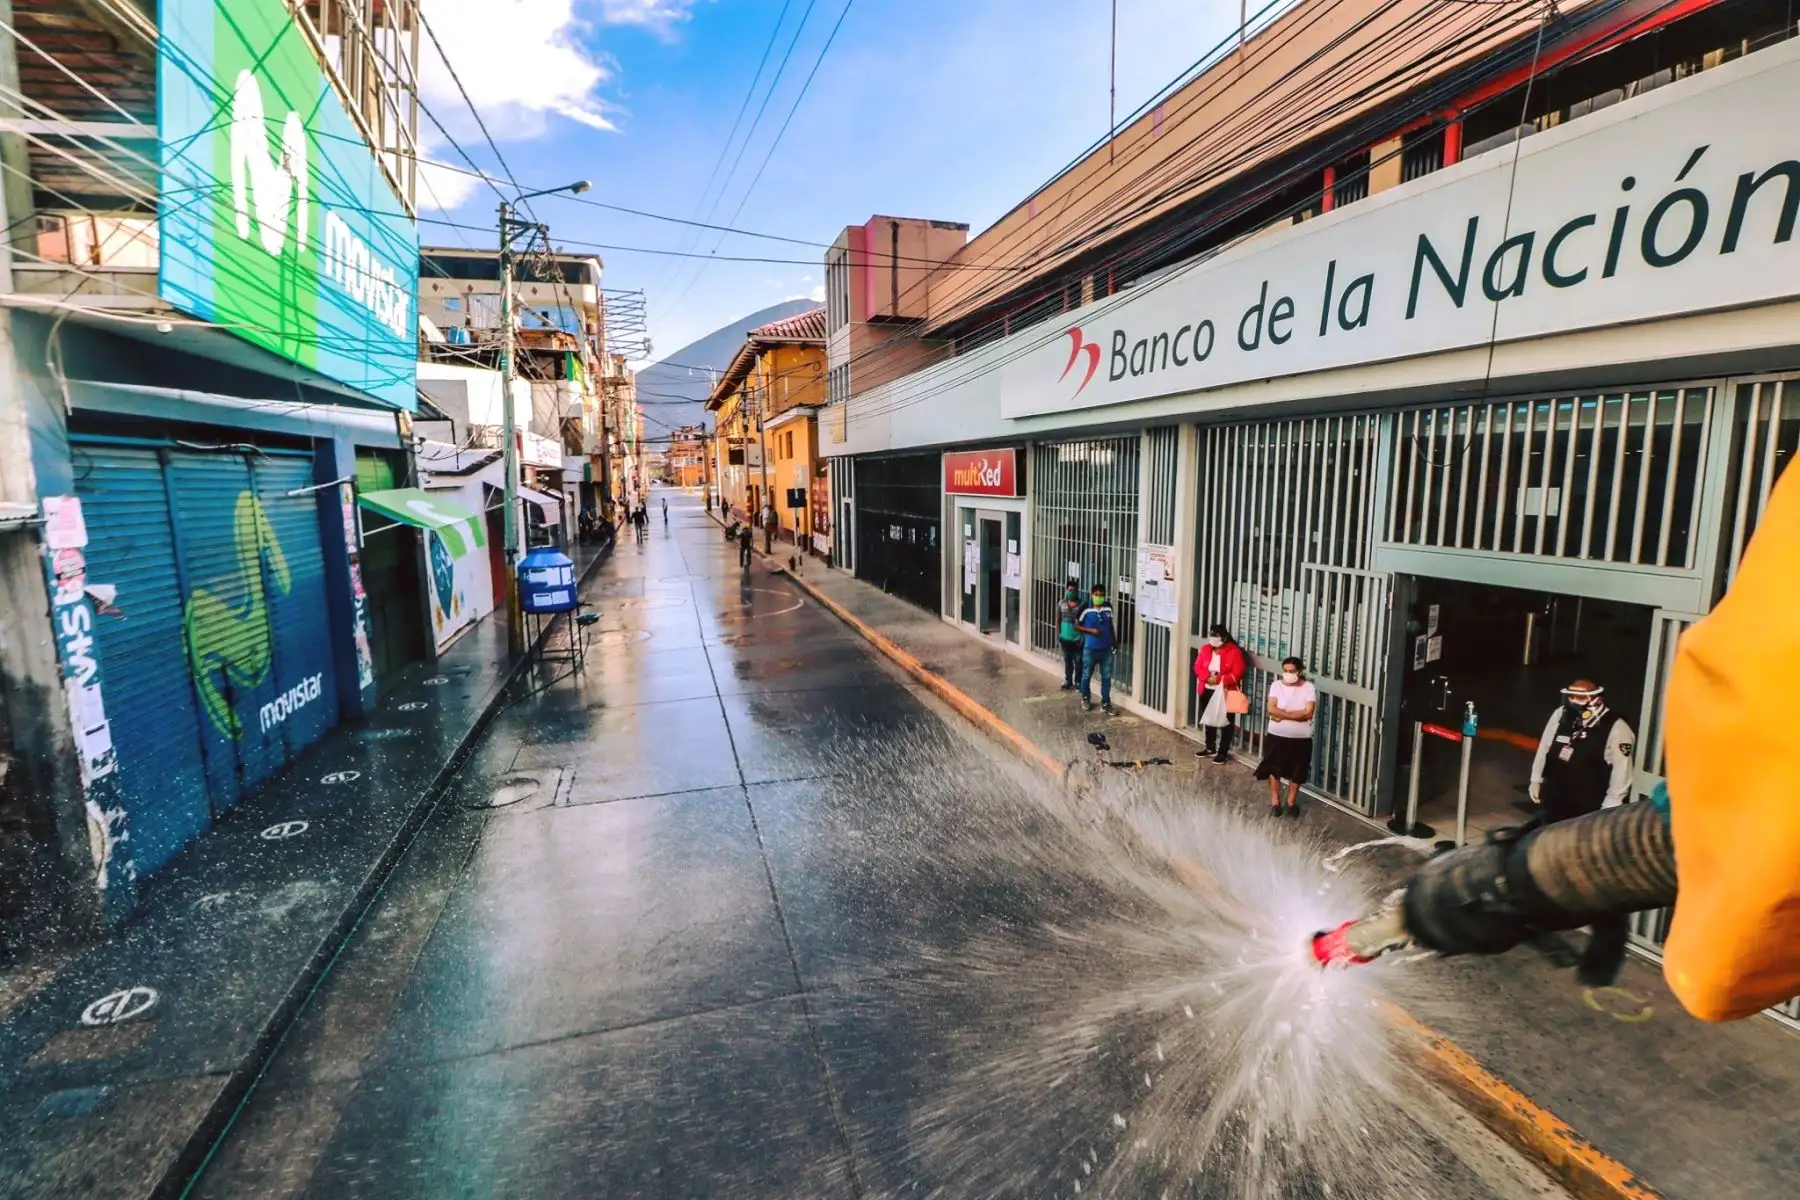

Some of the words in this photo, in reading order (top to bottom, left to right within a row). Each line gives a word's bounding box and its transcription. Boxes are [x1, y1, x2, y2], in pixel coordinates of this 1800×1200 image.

[324, 209, 409, 341] movistar
[1109, 319, 1215, 382] Banco
[1237, 280, 1295, 351] de
[1319, 259, 1375, 337] la
[1405, 144, 1800, 320] Nación
[260, 672, 322, 734] movistar
